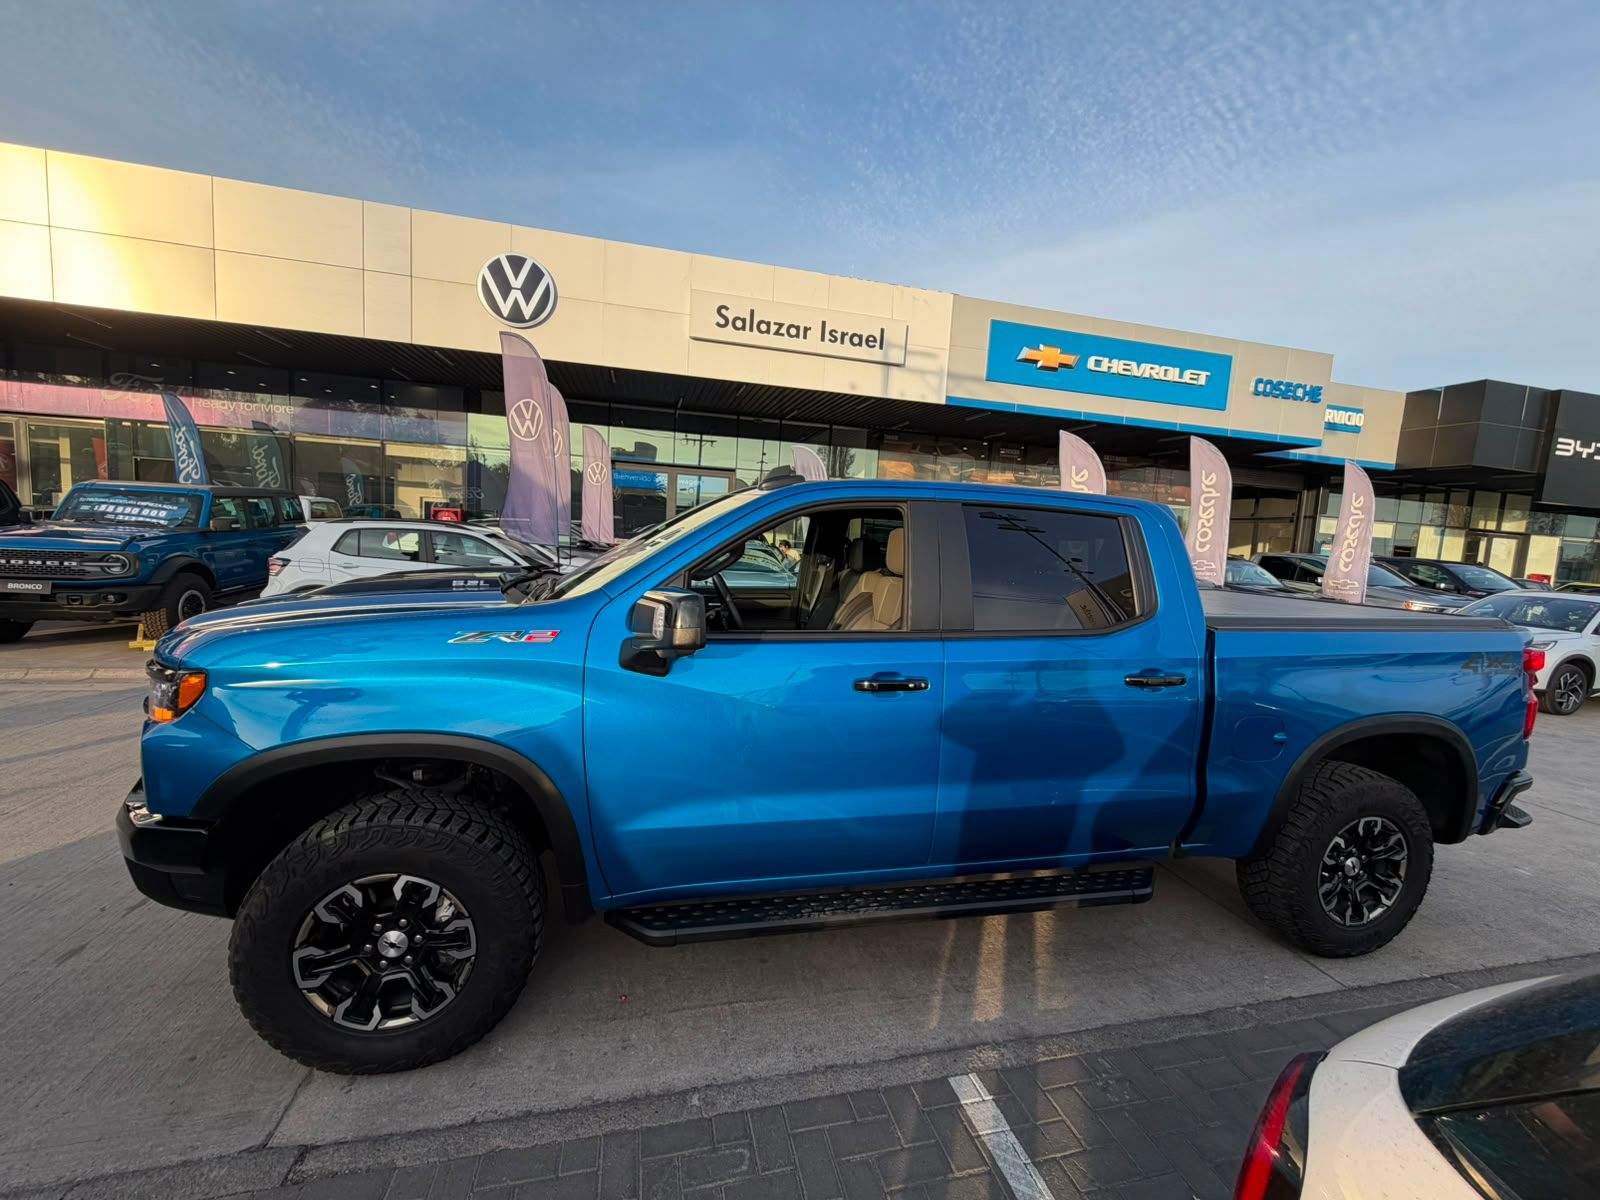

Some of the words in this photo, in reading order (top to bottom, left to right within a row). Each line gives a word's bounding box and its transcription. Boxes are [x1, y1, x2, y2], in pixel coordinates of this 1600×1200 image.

[714, 304, 812, 340] Salazar
[820, 320, 886, 350] Israel
[1086, 355, 1212, 387] CHEVROLET
[1253, 377, 1323, 404] COSECHE
[193, 396, 236, 410] Ready
[237, 397, 258, 411] for
[261, 402, 295, 414] More
[7, 582, 43, 591] BRONCO
